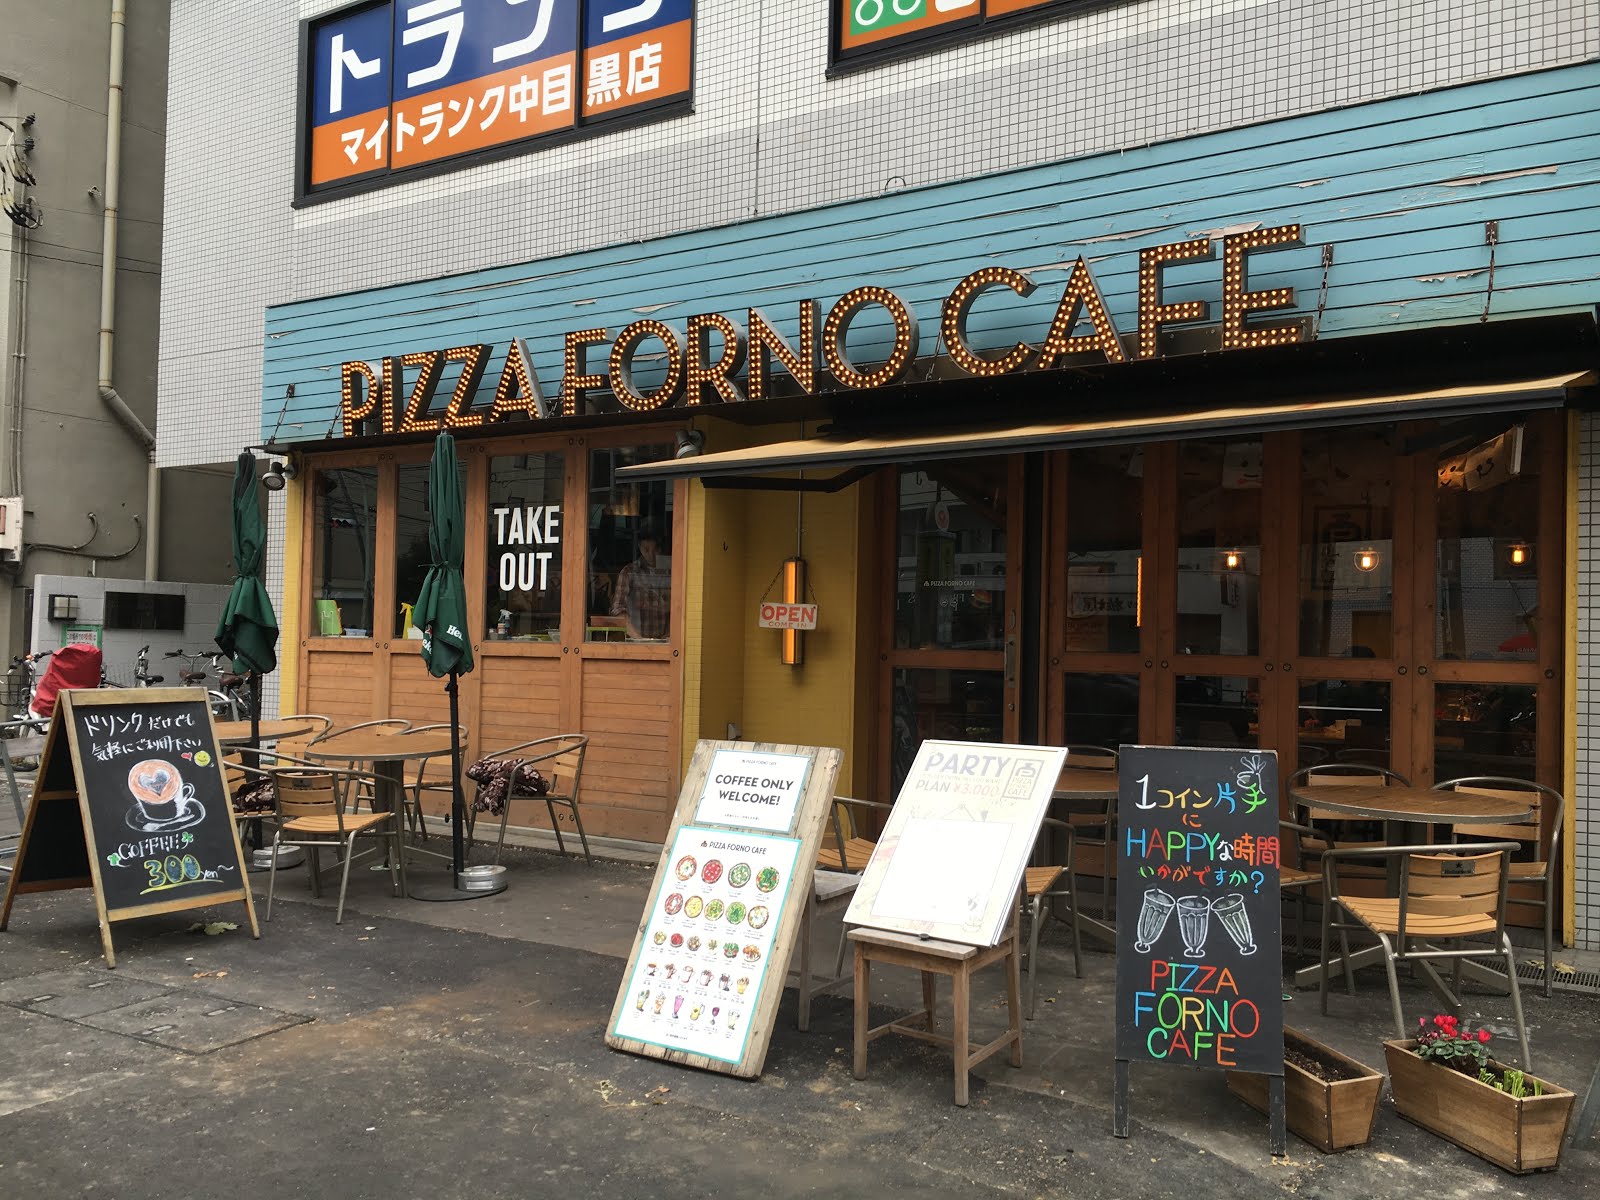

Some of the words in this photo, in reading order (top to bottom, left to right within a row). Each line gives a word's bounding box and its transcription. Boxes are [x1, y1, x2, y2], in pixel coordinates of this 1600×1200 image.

[340, 42, 663, 165] マイトランク中目黒店
[341, 338, 543, 438] PIZZA
[563, 286, 920, 416] FORNO
[941, 223, 1306, 378] CAFE
[494, 505, 560, 546] TAKE
[500, 552, 552, 592] OUT
[761, 605, 815, 622] OPEN
[924, 752, 1012, 777] PARTY
[715, 774, 759, 788] COFFEE
[761, 778, 794, 791] ONLY
[719, 790, 781, 806] WELCOME!
[915, 779, 951, 793] PLAN
[1182, 813, 1202, 828] に
[709, 841, 726, 850] PIZZA
[727, 843, 751, 853] FORNO
[751, 846, 767, 855] CAFE
[143, 853, 201, 888] 300
[1151, 960, 1239, 996] PIZZA
[1135, 991, 1260, 1038] FORNO
[1147, 1027, 1237, 1067] CAFE
